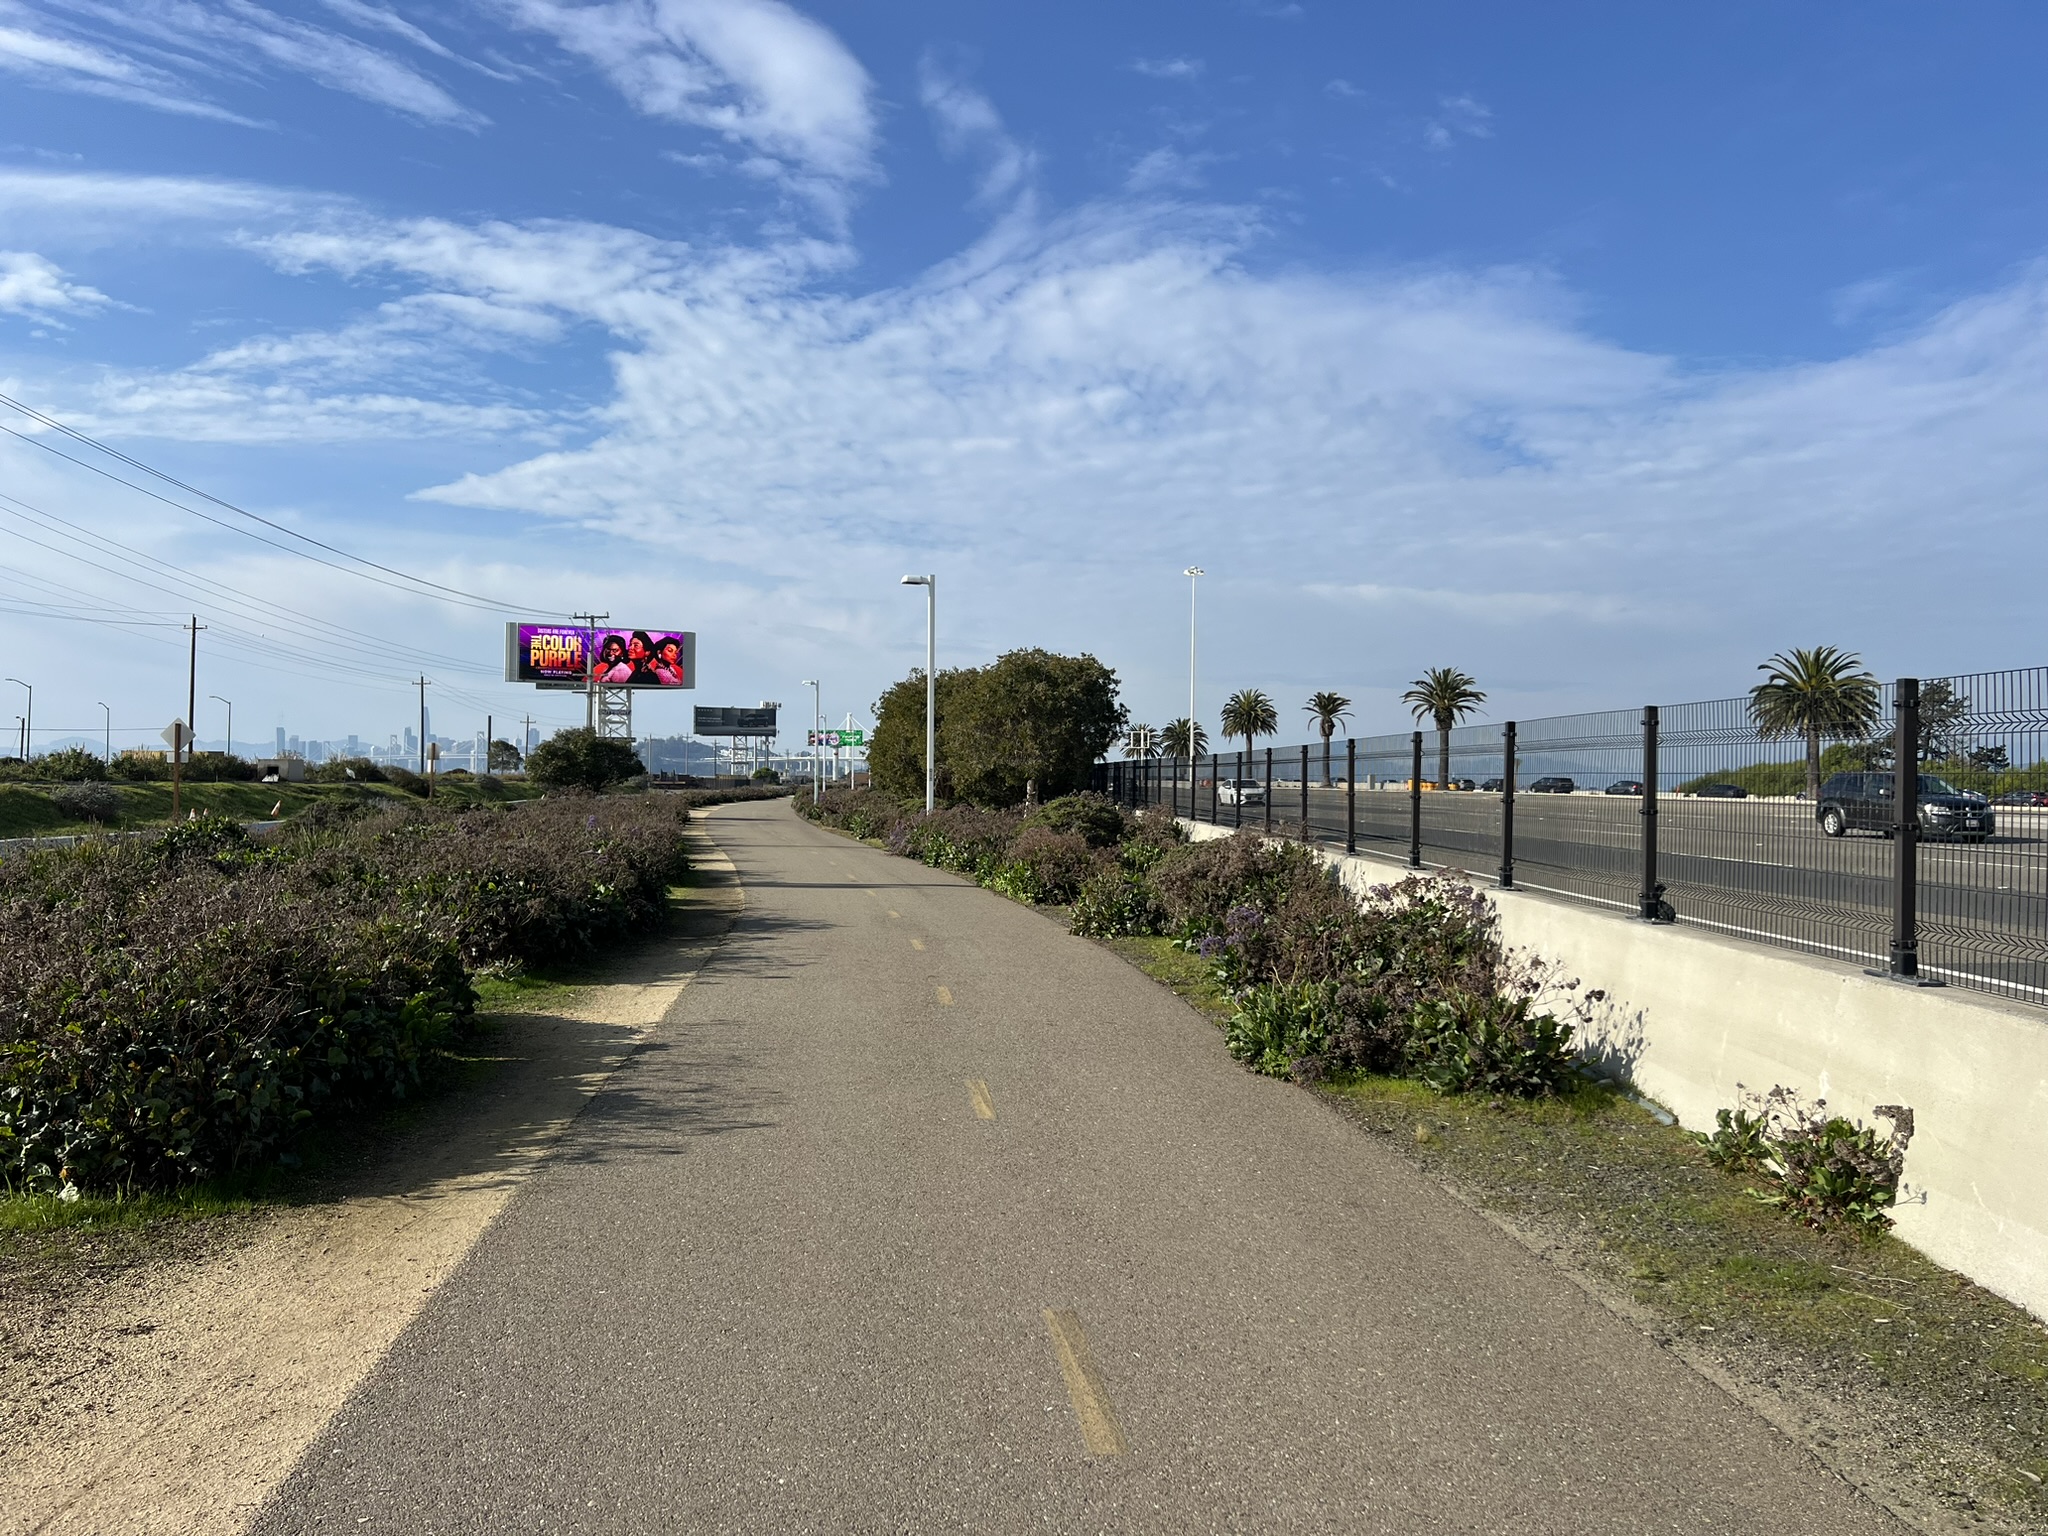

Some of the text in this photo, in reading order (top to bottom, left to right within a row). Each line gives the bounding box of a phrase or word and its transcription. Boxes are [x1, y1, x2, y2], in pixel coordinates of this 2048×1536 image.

[530, 634, 582, 652] THE COLOR
[530, 649, 582, 668] PURPLE
